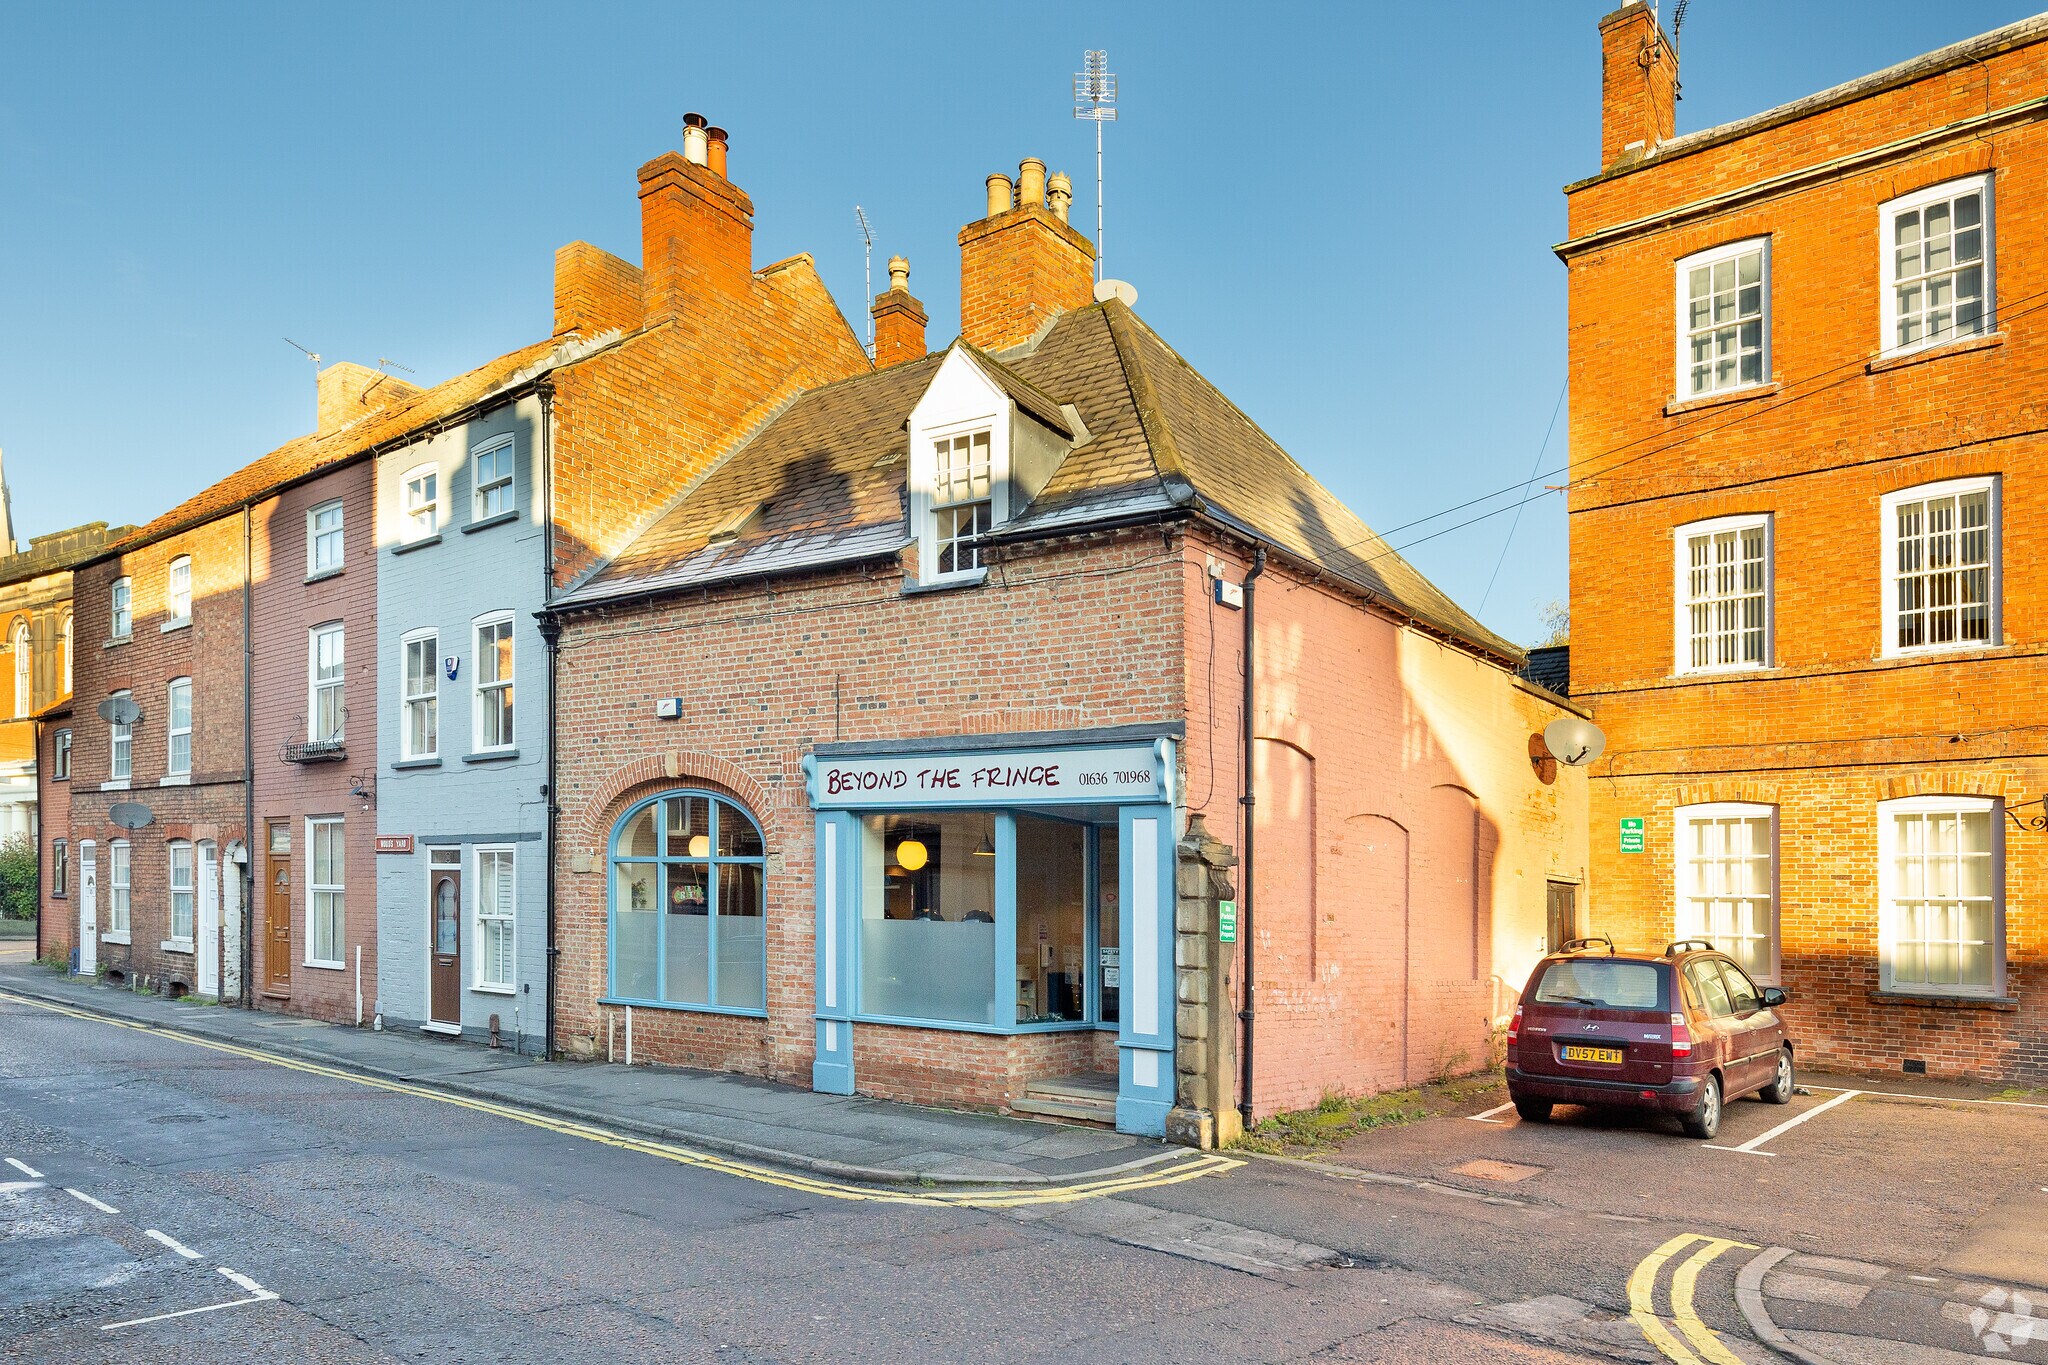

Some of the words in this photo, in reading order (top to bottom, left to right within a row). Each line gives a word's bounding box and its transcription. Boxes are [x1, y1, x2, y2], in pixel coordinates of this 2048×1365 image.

[827, 768, 908, 795] BEYOND
[916, 768, 961, 789] THE
[971, 765, 1060, 788] FRINGE
[1078, 772, 1108, 786] 01636
[1113, 769, 1151, 784] 701968
[1621, 827, 1643, 836] Parking
[1621, 843, 1643, 851] Property
[1568, 1047, 1596, 1060] DV57
[1598, 1049, 1620, 1062] EWT
